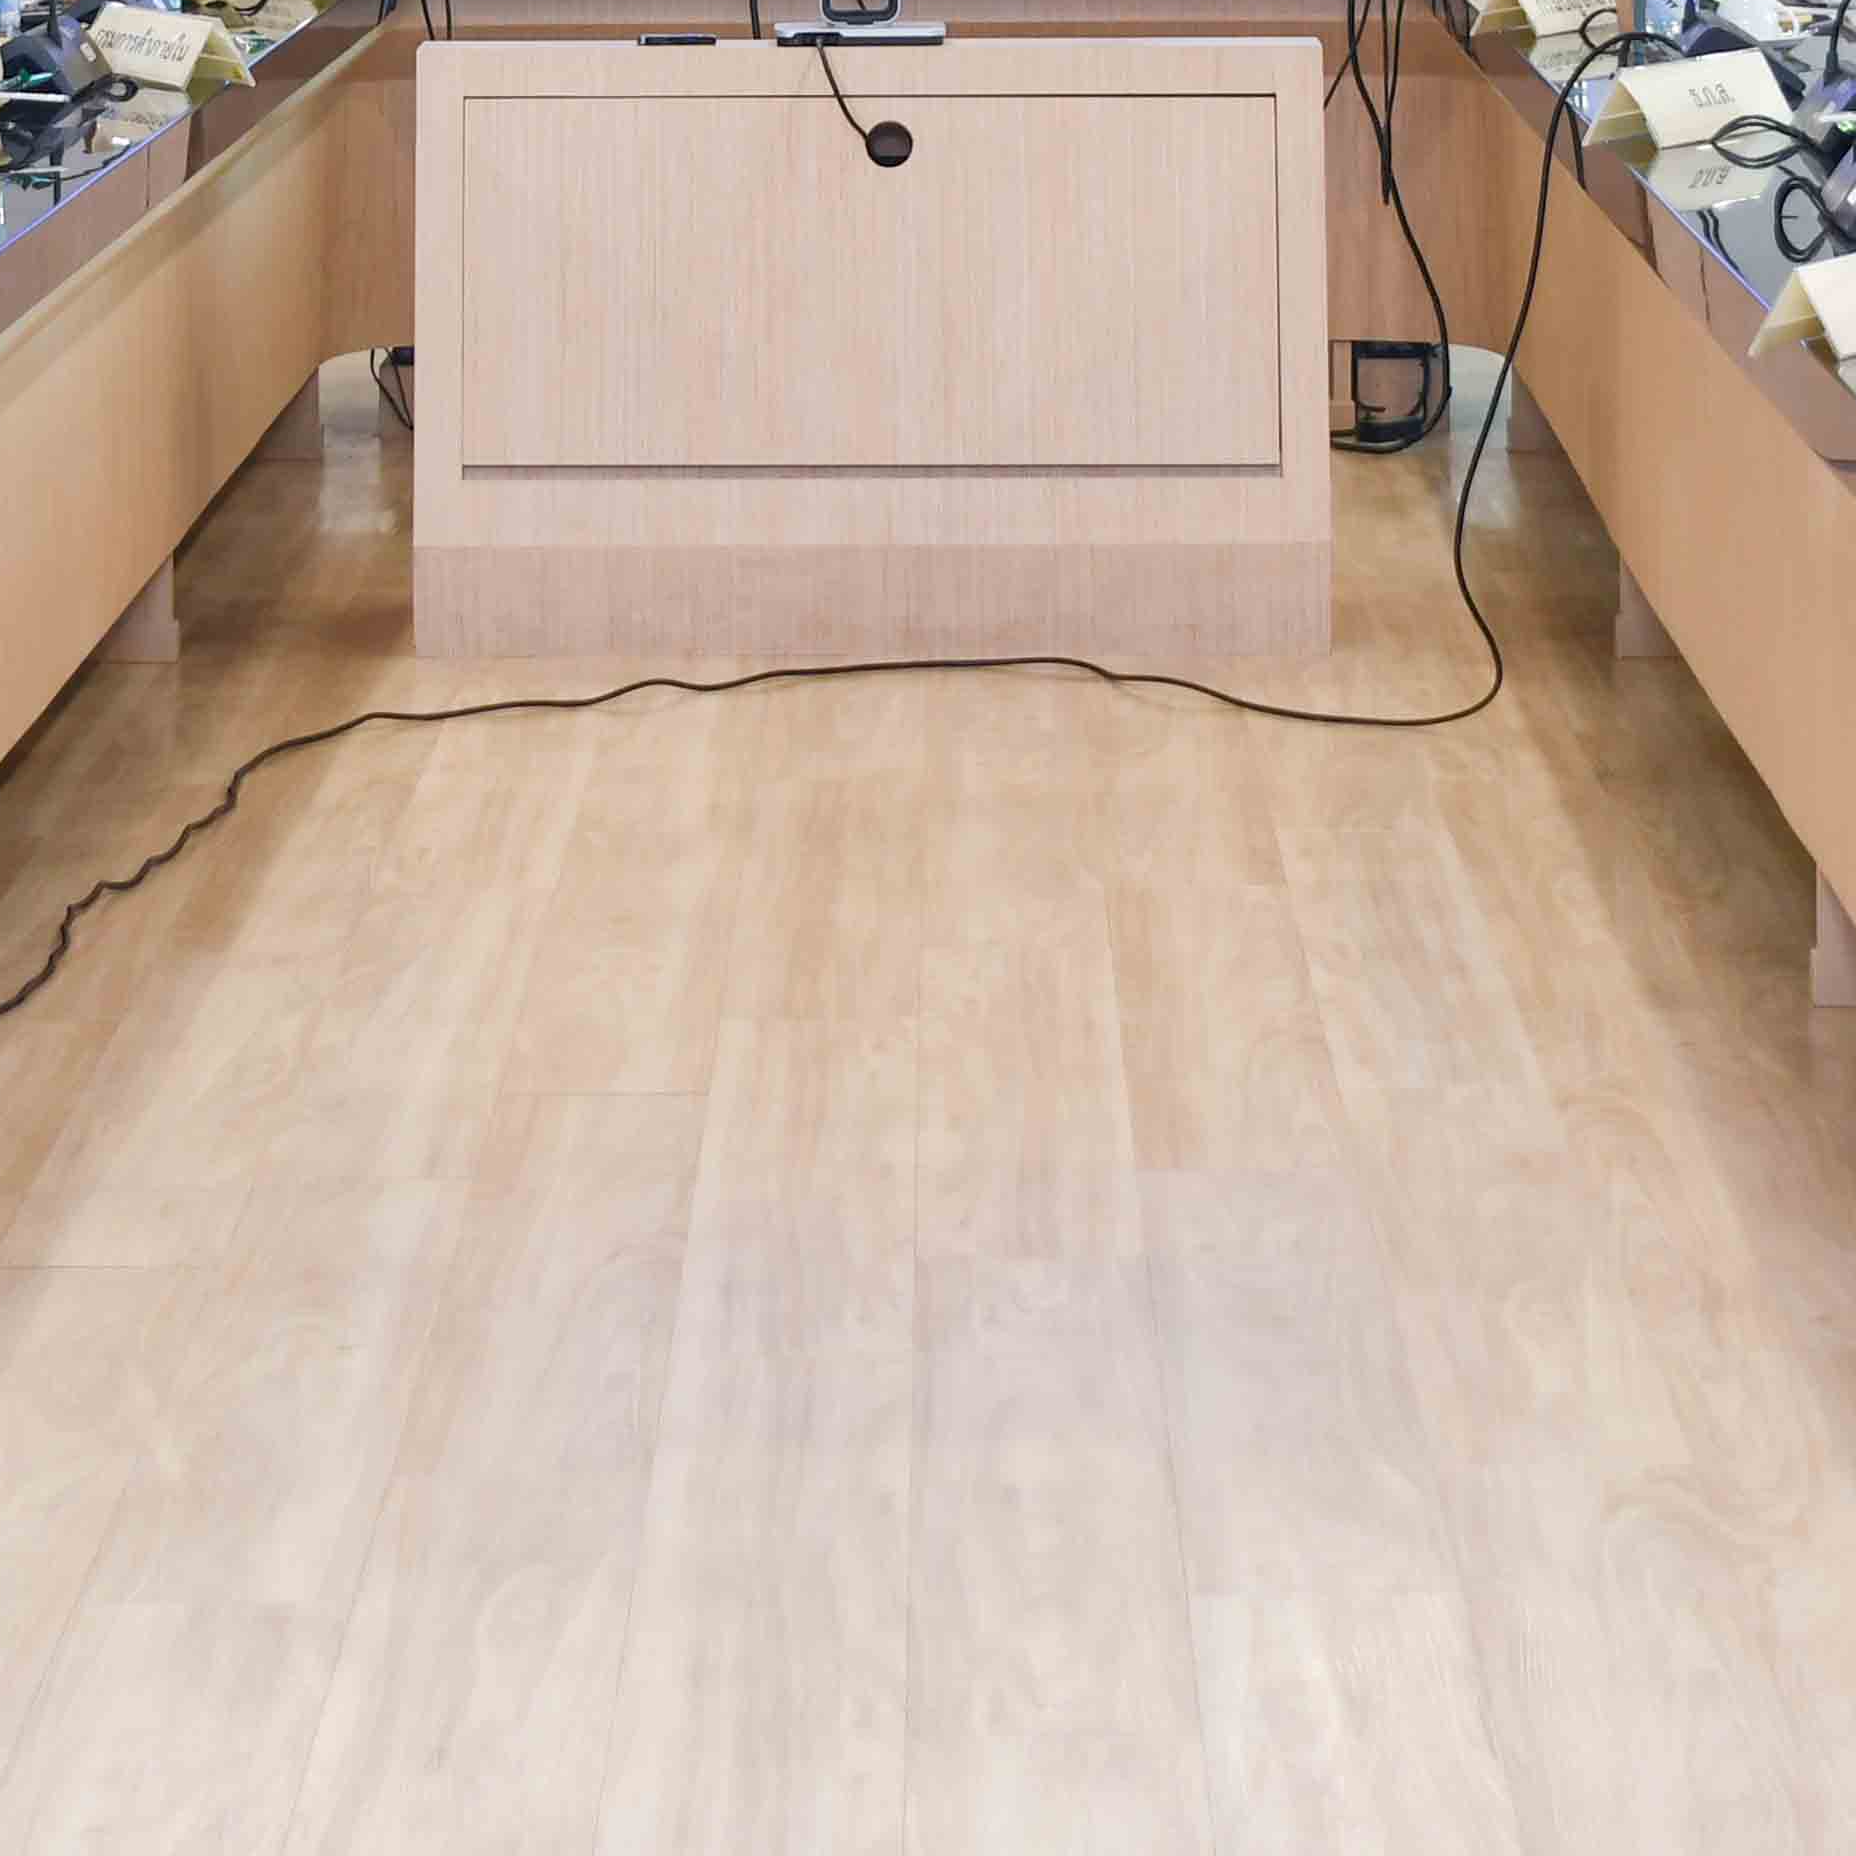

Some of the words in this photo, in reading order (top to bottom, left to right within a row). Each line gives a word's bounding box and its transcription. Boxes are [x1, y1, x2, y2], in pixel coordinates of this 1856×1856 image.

[96, 25, 192, 64] กรมการค้าภายใน
